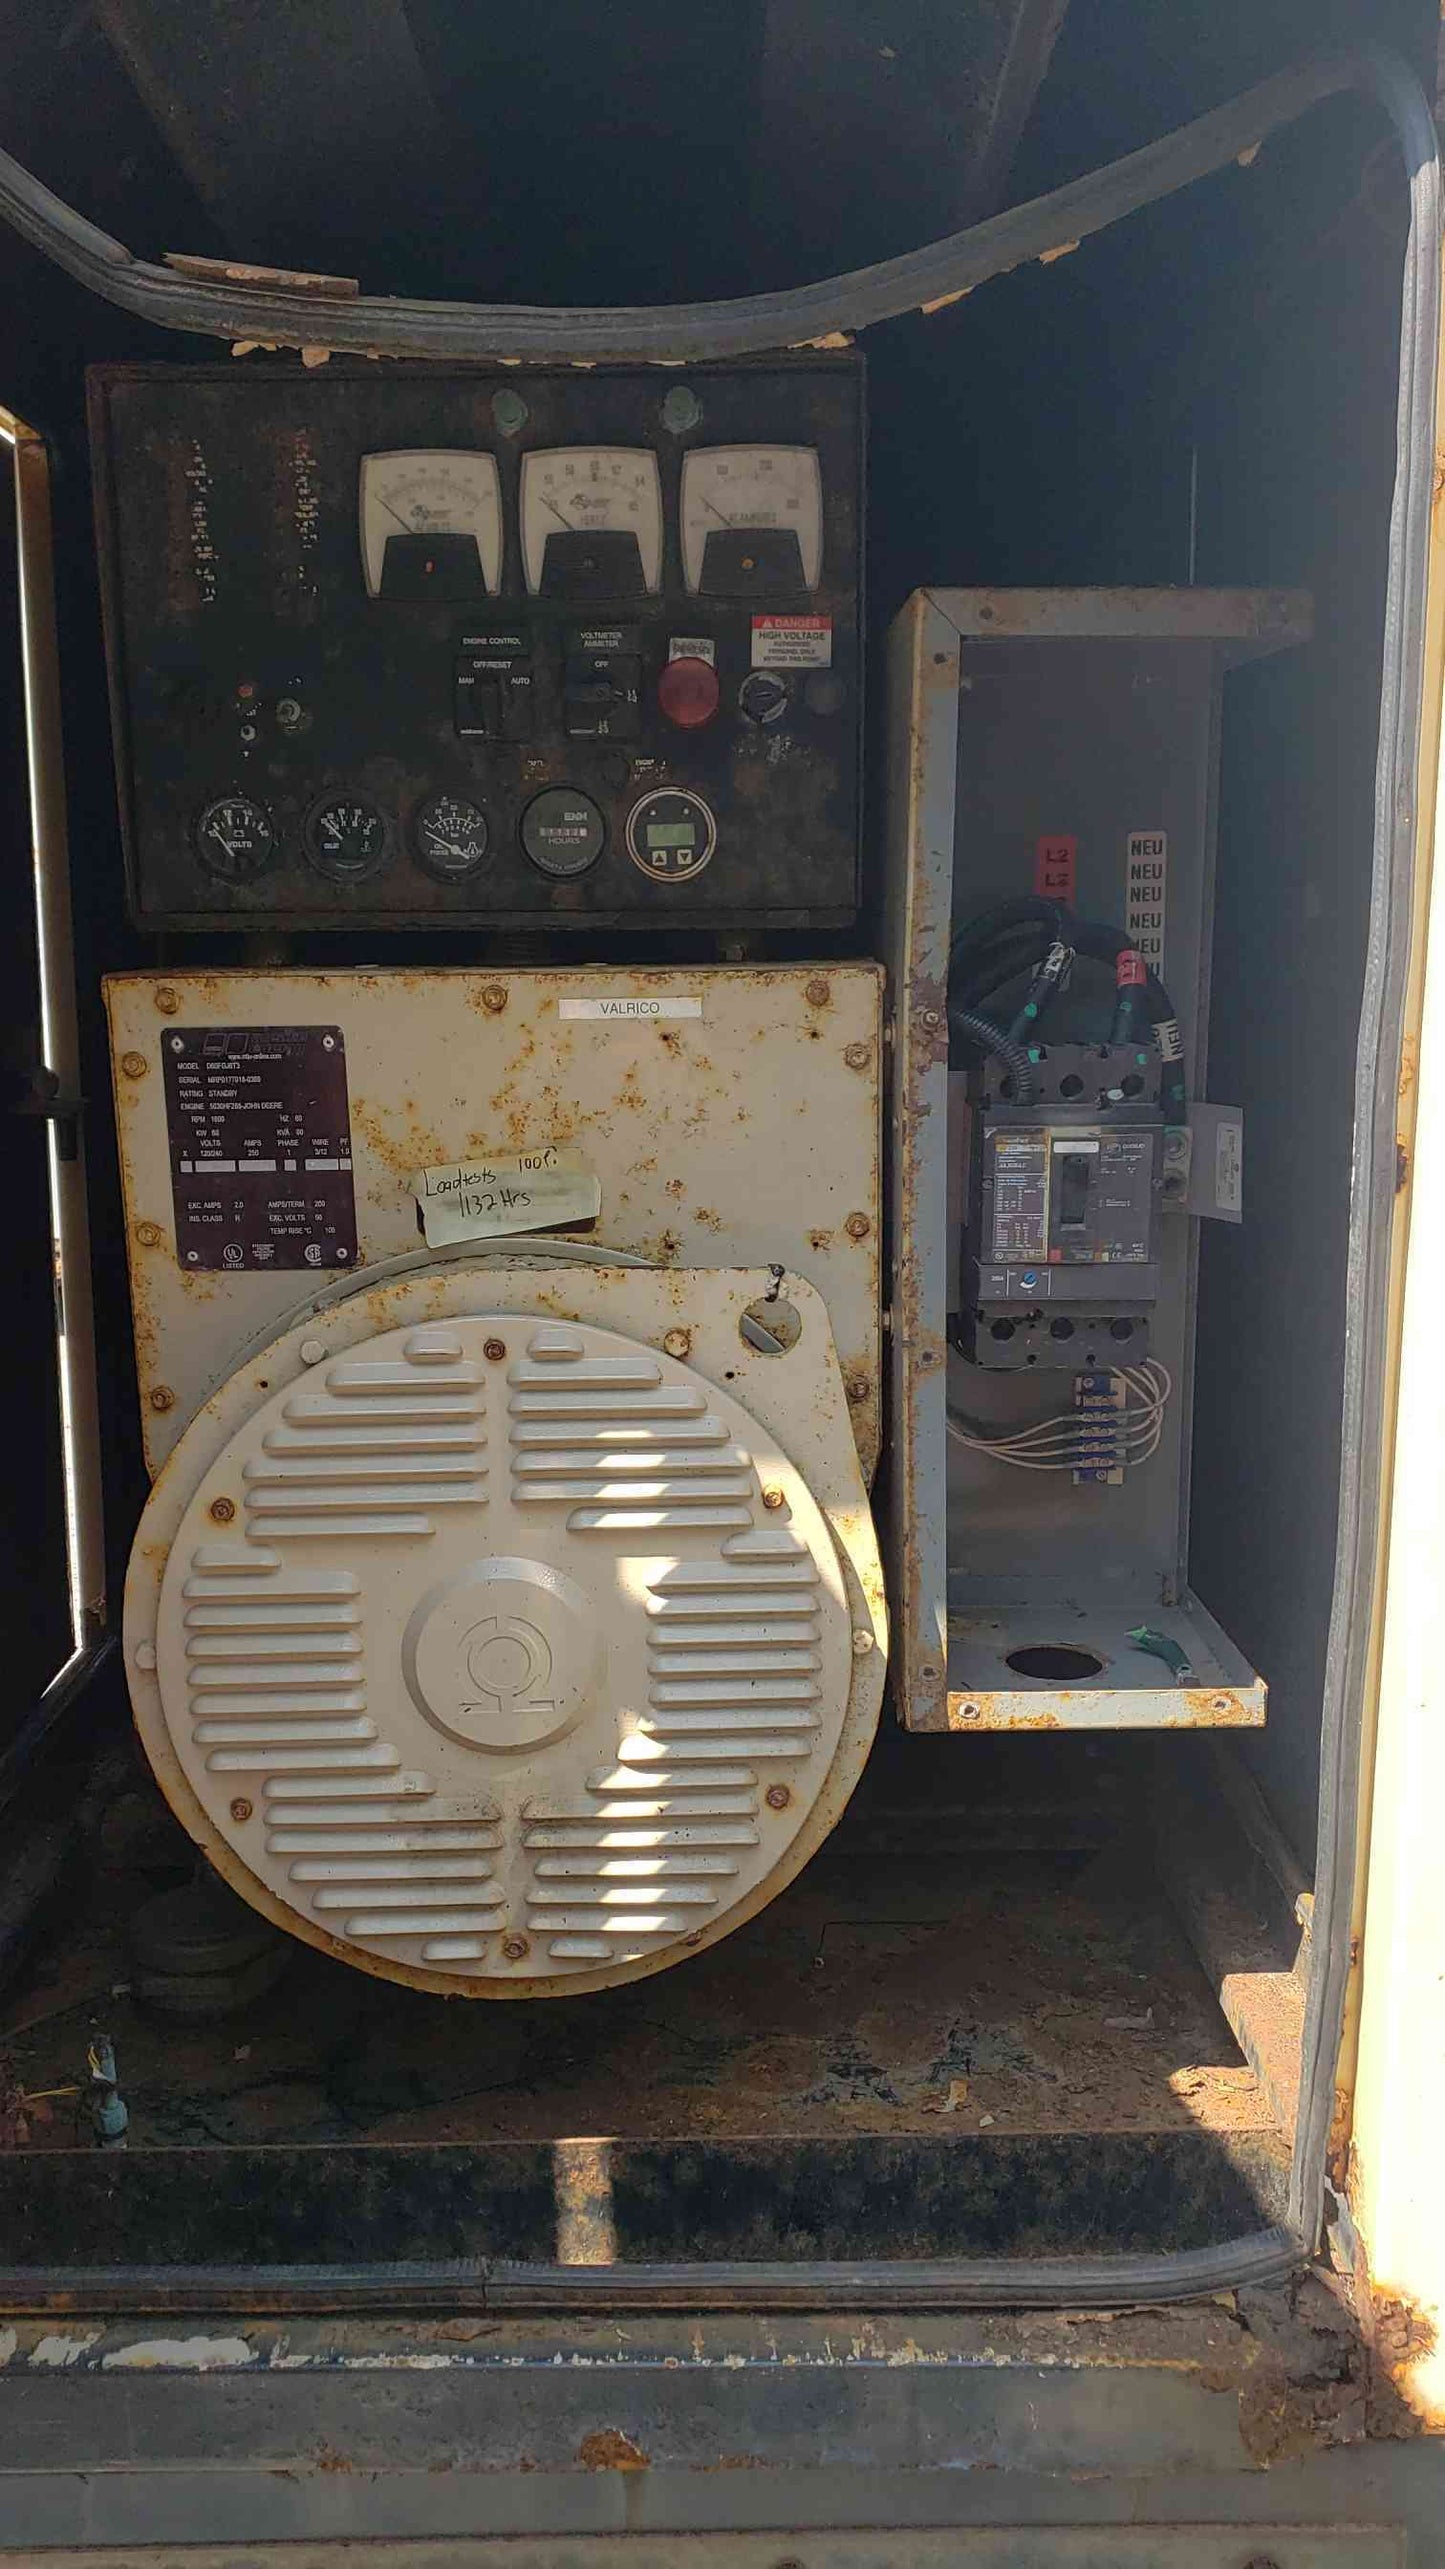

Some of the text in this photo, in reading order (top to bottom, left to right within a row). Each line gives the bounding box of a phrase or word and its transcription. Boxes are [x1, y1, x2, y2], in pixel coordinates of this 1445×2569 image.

[775, 618, 820, 628] DANGER
[759, 631, 825, 640] HIGH VOLTAGE
[489, 637, 521, 645] CONTROL
[594, 660, 609, 668] OFF
[510, 676, 530, 685] AUTO
[227, 840, 252, 848] VOLTS
[548, 837, 581, 845] HOURS
[1131, 839, 1163, 856] NEU
[1046, 849, 1069, 863] L2
[1131, 864, 1162, 880] NEU
[1130, 886, 1161, 903] NEU
[1130, 913, 1161, 928] NEU
[600, 1001, 660, 1015] VALRICO
[177, 1062, 199, 1070] MODEL
[178, 1076, 200, 1084] SERIAL
[179, 1089, 238, 1098] RATING STANDBY
[180, 1102, 204, 1111] ENGINE
[261, 1101, 284, 1109] DEERE
[191, 1115, 206, 1124] RPM
[279, 1114, 289, 1122] HZ
[277, 1128, 290, 1136] KVA
[200, 1139, 221, 1147] VOLTS
[243, 1138, 262, 1147] AMPS
[277, 1138, 300, 1147] PHASE
[311, 1138, 329, 1146] WIRE
[203, 1201, 222, 1209] AMPS
[234, 1201, 244, 1209] 2.0
[268, 1200, 305, 1208] AMPS/TERM
[458, 1188, 531, 1217] 1132 Hrs
[198, 1215, 223, 1223] CLASS
[284, 1214, 306, 1222] VOLTS
[270, 1227, 288, 1235] TEMP
[288, 1227, 303, 1235] RISE
